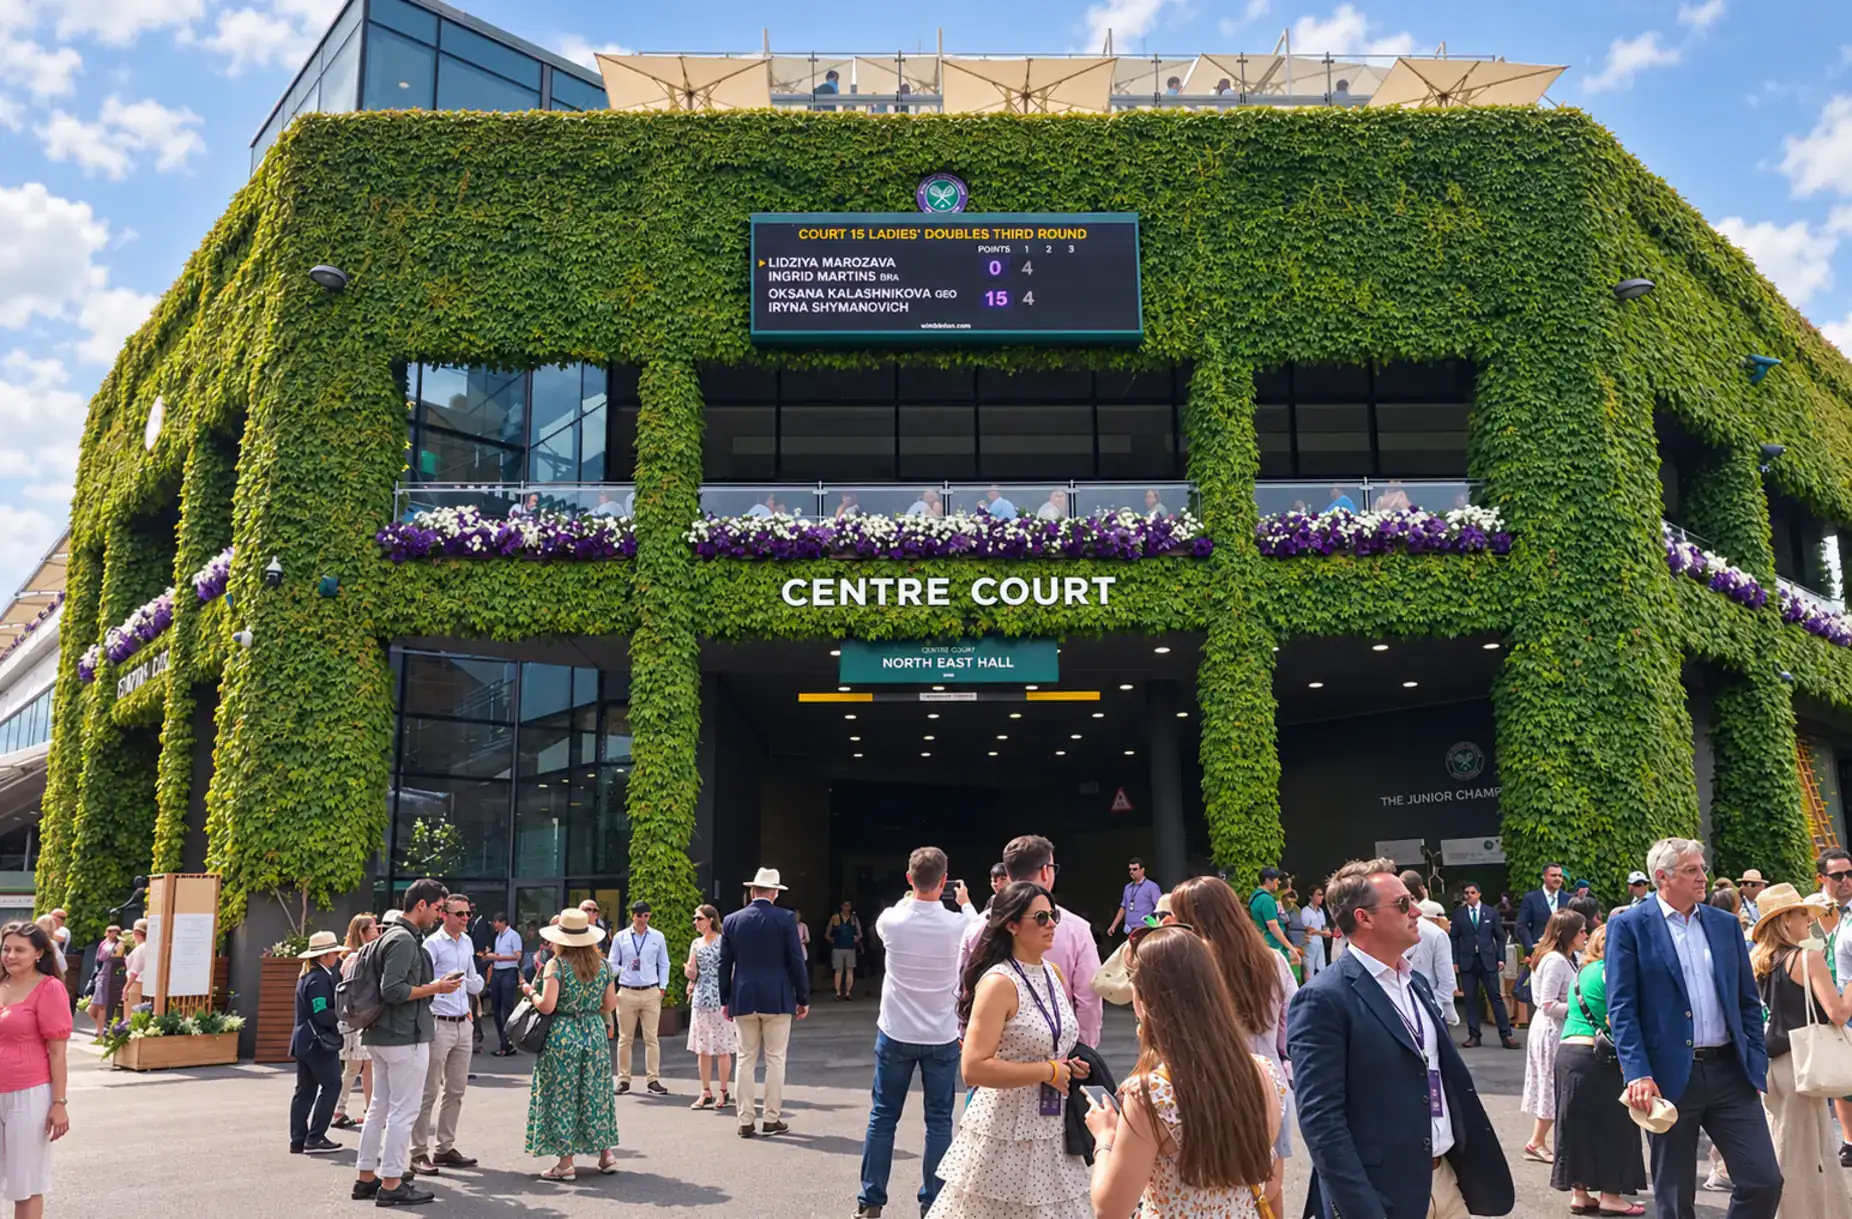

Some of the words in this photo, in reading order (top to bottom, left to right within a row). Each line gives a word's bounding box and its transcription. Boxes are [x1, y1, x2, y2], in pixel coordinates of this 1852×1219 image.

[798, 228, 847, 240] COURT
[850, 228, 866, 240] 15
[869, 228, 921, 240] LADIES'
[924, 228, 990, 240] DOUBLES
[992, 228, 1035, 240] THIRD
[1038, 228, 1087, 240] ROUND
[978, 245, 1011, 254] POINTS
[1024, 245, 1029, 254] 1
[1045, 245, 1052, 254] 2
[1068, 245, 1075, 254] 3
[768, 256, 819, 268] LIDZIYA
[822, 256, 897, 268] MAROZAVA
[989, 261, 1001, 275] 0
[1021, 261, 1034, 275] 4
[768, 270, 814, 282] INGRID
[817, 270, 876, 282] MARTINS
[880, 273, 900, 282] BRA
[768, 287, 825, 300] OKSANA
[828, 287, 932, 299] KALASHNIKOVA
[935, 289, 958, 299] GEO
[985, 290, 1008, 306] 15
[1022, 290, 1035, 306] 4
[768, 301, 809, 313] IRYNA
[811, 301, 909, 313] SHYMANOVICH
[781, 577, 950, 607] CENTRE
[970, 576, 1116, 606] COURT
[882, 657, 932, 669] NORTH
[937, 657, 974, 668] EAST
[978, 657, 1015, 668] HALL
[1380, 795, 1404, 807] THE
[1407, 791, 1453, 805] JUNIOR
